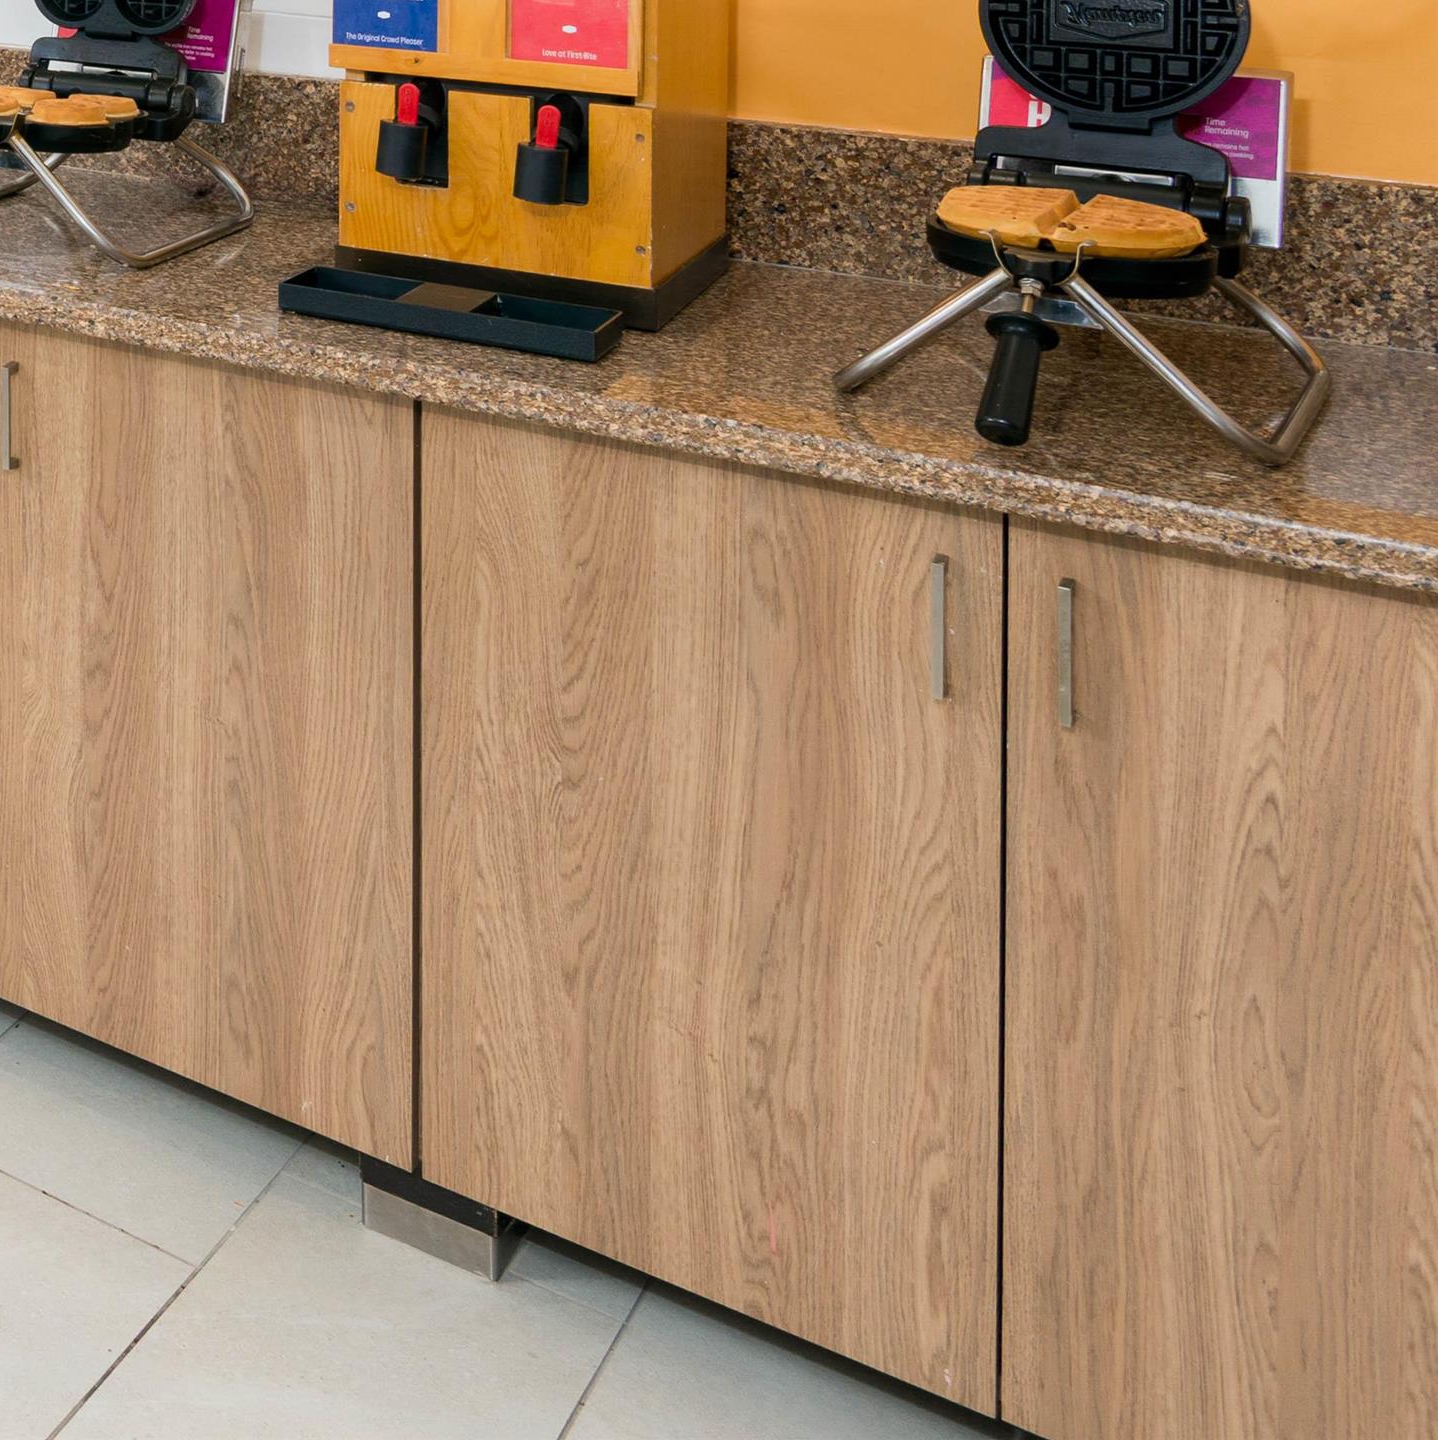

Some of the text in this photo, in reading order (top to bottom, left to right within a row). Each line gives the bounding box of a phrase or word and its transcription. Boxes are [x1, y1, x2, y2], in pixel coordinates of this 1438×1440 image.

[346, 31, 424, 45] The Original Crowd Pleaser
[542, 48, 557, 57] Love
[557, 50, 566, 58] at
[1206, 117, 1225, 126] Time
[1205, 125, 1249, 139] Remaining
